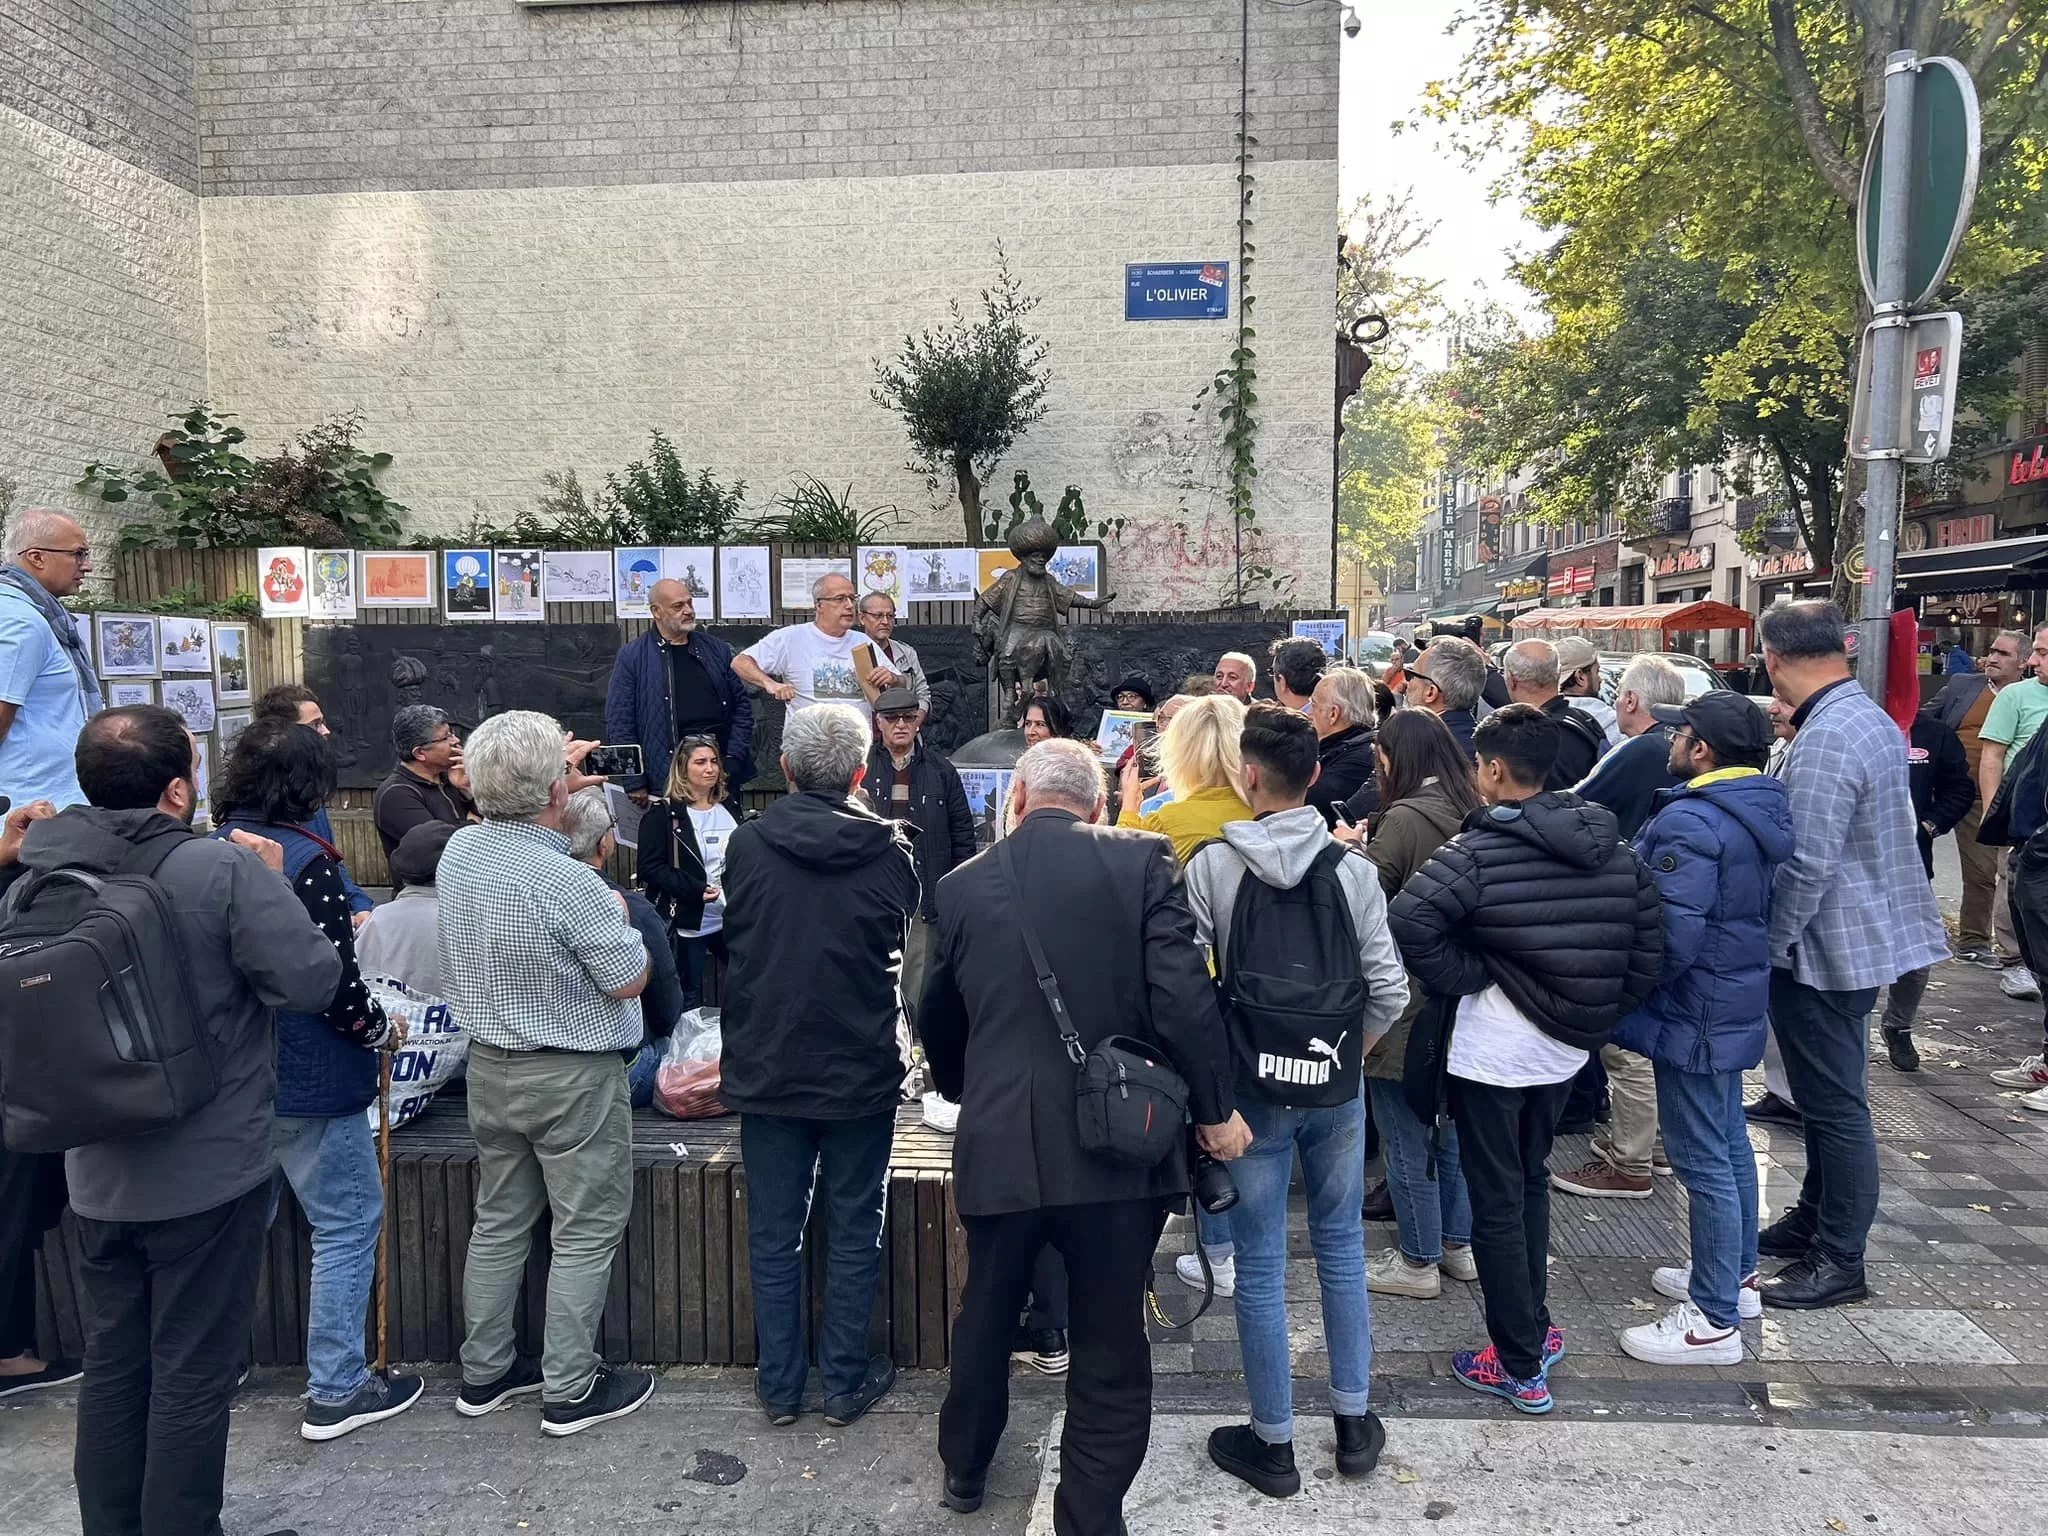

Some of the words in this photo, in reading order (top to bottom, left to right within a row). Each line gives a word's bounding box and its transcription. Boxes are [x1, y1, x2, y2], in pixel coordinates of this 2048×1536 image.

[1146, 288, 1208, 302] L'OLIVIER
[1443, 530, 1455, 586] MARKET
[1678, 548, 1701, 572] Pide
[1758, 556, 1780, 576] Lale
[1782, 551, 1805, 573] Pide
[1258, 1052, 1331, 1085] PUMA
